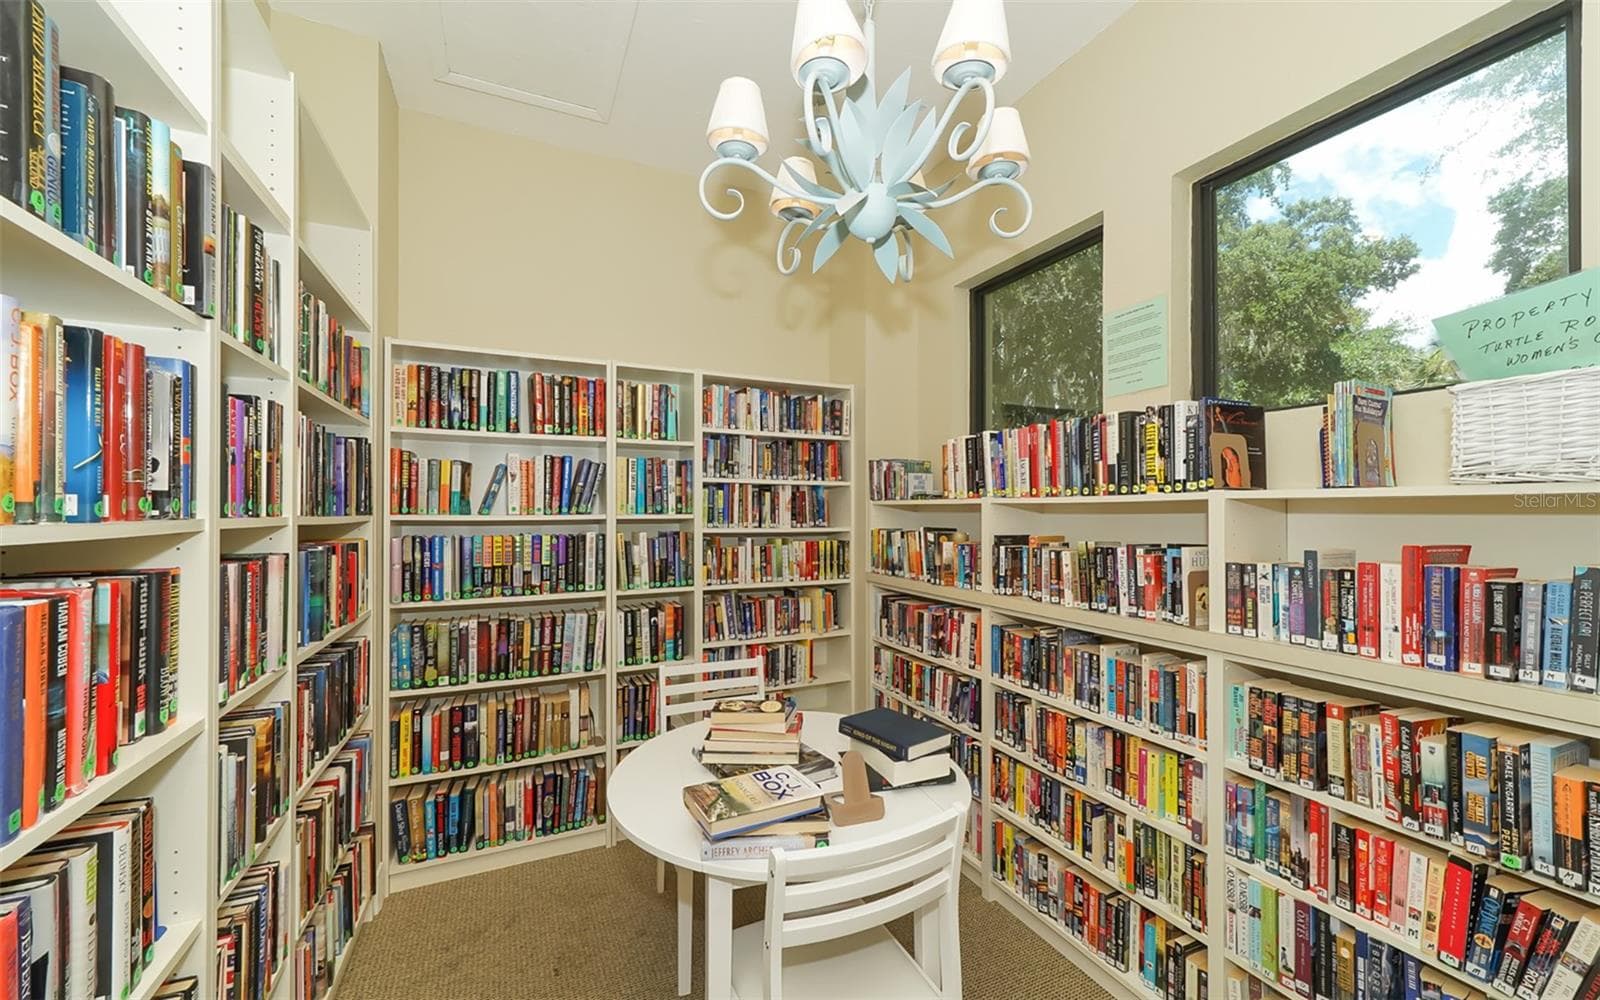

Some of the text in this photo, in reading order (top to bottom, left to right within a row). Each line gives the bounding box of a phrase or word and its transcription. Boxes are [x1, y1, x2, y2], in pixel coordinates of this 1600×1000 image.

[32, 1, 45, 139] DAVID BALDACCI
[47, 155, 57, 207] GENIUS
[1462, 287, 1592, 339] PROPERTY
[1478, 330, 1545, 355] TURTLE
[1505, 336, 1580, 367] WOMEN'S
[9, 354, 20, 401] BOX
[1146, 424, 1158, 477] STEVEN TYLER
[1494, 591, 1503, 603] LONE
[1579, 580, 1594, 637] THE PERFECT GIRL
[58, 601, 68, 643] HARLAN
[138, 582, 148, 681] ROBIN COOK
[58, 644, 68, 678] COBEN
[160, 666, 170, 696] BLOW
[57, 728, 67, 769] MISSING
[1476, 755, 1487, 779] HARD
[752, 771, 794, 801] BOX
[1504, 746, 1515, 824] MICHAEL McGARRITY
[711, 846, 770, 858] JEFFREY ARCHE
[1502, 829, 1510, 852] PEAK
[86, 854, 97, 905] GREEN
[119, 843, 127, 895] DELINSKY
[1297, 909, 1305, 939] OATES
[88, 931, 97, 961] TED
[1372, 950, 1381, 992] BEFORE
